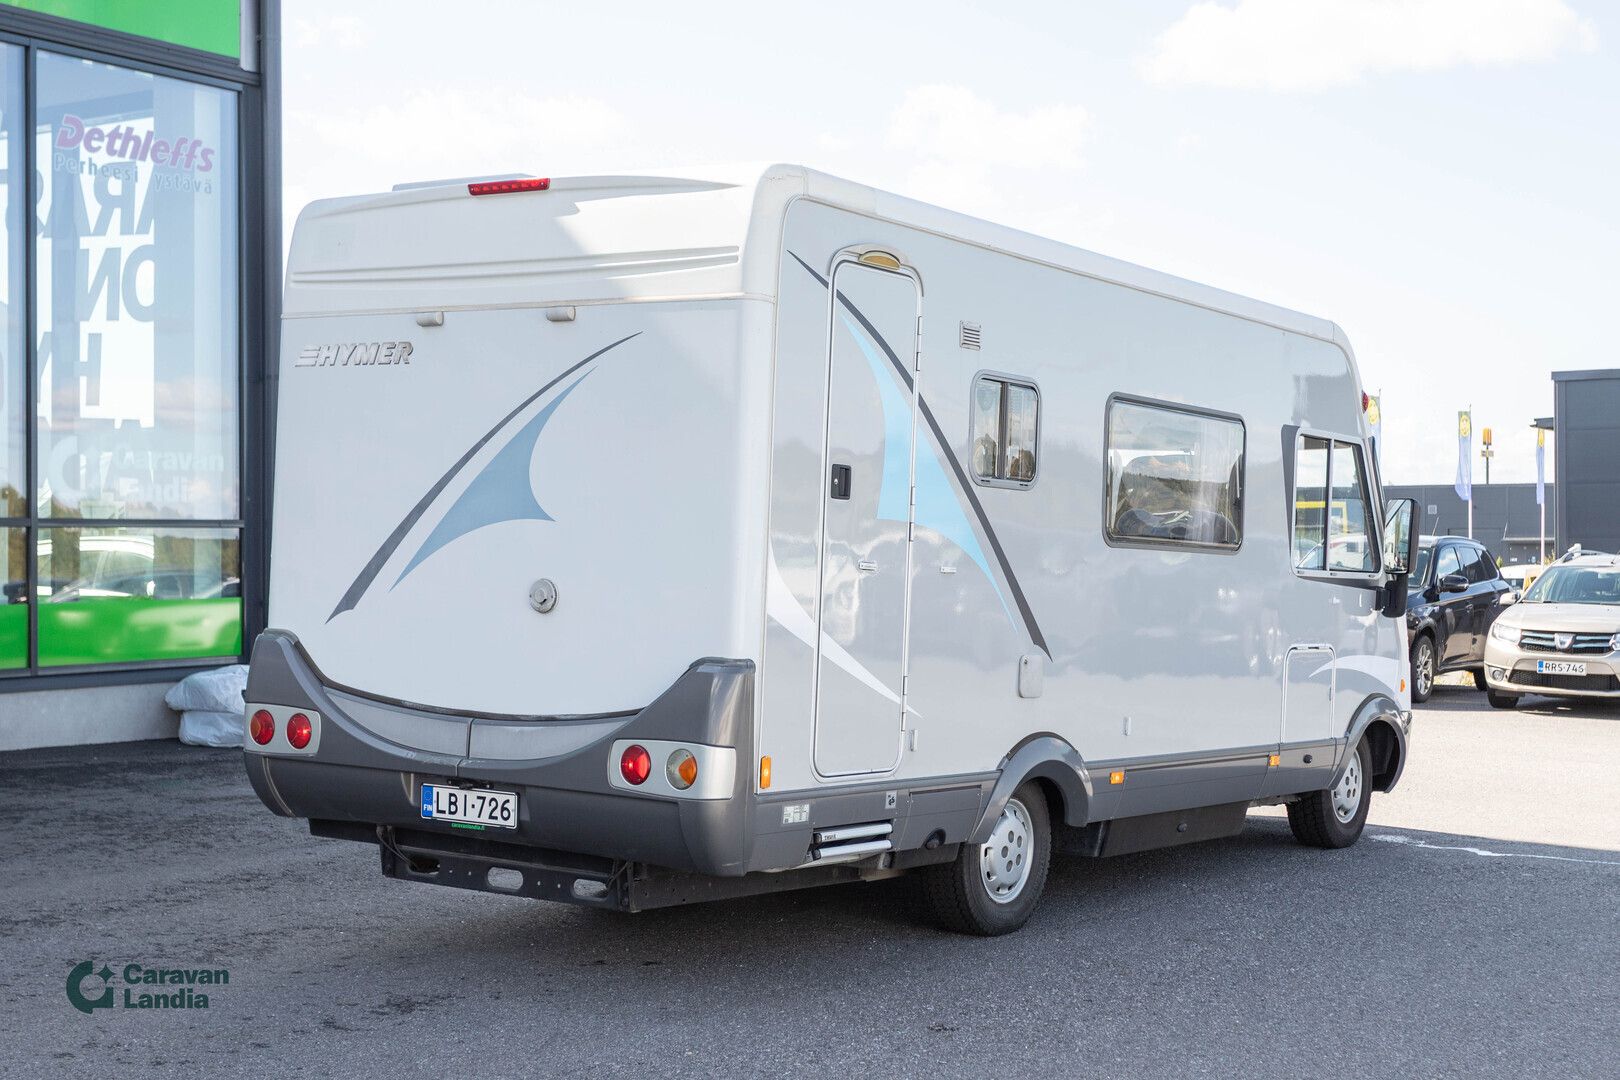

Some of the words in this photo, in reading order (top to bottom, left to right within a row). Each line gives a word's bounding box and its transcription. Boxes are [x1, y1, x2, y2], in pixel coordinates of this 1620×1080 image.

[55, 114, 215, 172] Dethleffs
[54, 153, 139, 183] Perheesi
[312, 341, 414, 367] HYMER
[112, 443, 225, 473] Caravan
[423, 803, 433, 812] FIN
[436, 791, 511, 821] LBI-726
